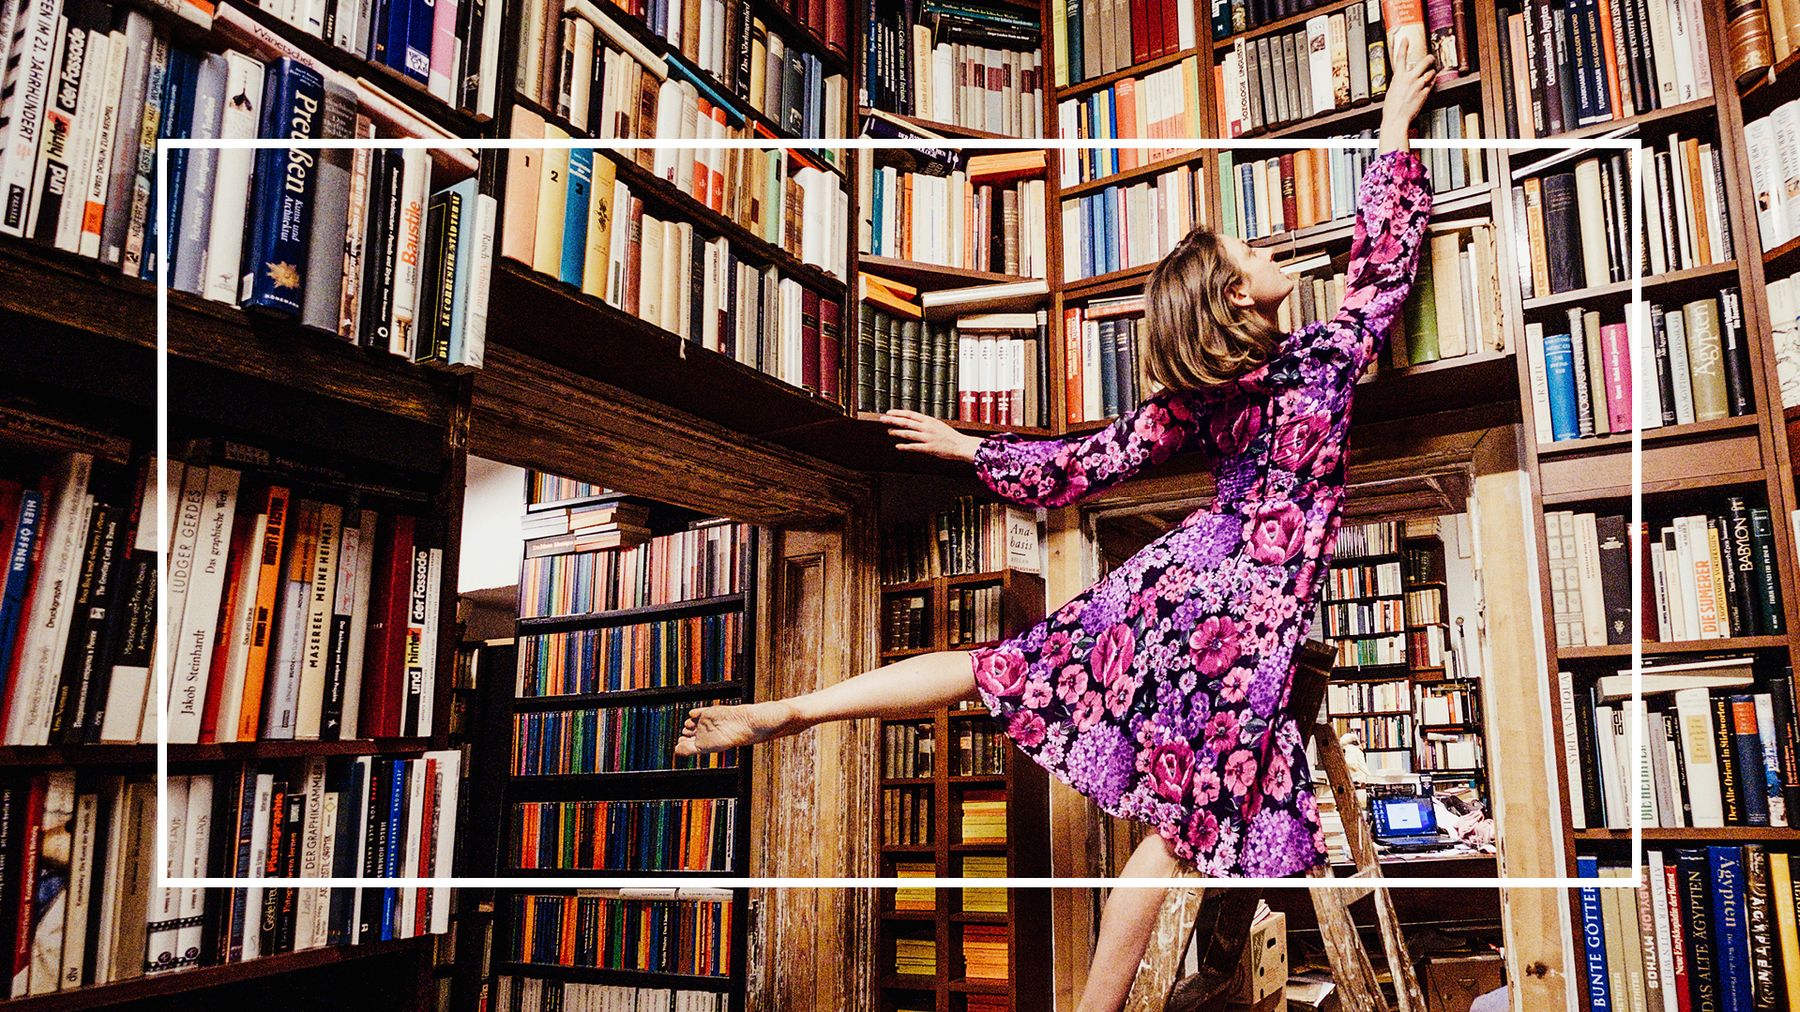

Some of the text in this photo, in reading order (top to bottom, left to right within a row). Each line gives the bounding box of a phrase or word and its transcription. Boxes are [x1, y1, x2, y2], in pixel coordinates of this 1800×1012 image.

[19, 19, 51, 143] IM 21. JAHRHUNDERT
[47, 27, 86, 196] und hinter der Fassade
[1236, 42, 1249, 121] SOZIOLOGIE LINGUISTIK
[285, 89, 318, 195] Preußen
[524, 155, 530, 168] 1
[550, 170, 559, 183] 2
[280, 194, 294, 243] Architektur
[291, 199, 304, 242] Kunst und
[575, 182, 584, 195] 3
[401, 201, 421, 266] Baustile
[1692, 303, 1719, 377] Ägypten
[13, 499, 37, 572] HIER ÖFFNEN
[172, 489, 201, 594] LUDGER GERDES
[207, 512, 226, 556] graphische
[1010, 523, 1033, 537] Ana-
[1010, 535, 1033, 551] basis
[1732, 517, 1754, 571] BABYLON
[205, 558, 216, 574] Das
[309, 522, 332, 668] MASEREEL MEINE HEIMAT
[1695, 560, 1718, 633] DIE SUMERER
[45, 579, 63, 629] Druckgraphik
[407, 551, 428, 694] und hinter der Fassade
[181, 629, 206, 716] Jakob Steinhardt
[1561, 674, 1578, 765] SYRIA ANTIQUA
[1717, 702, 1738, 821] Der Alte Orient in Stichworten
[266, 792, 284, 873] Photographie
[305, 764, 324, 870] DER GRAPHIKSAMMLER
[1641, 801, 1654, 821] DIE
[1665, 873, 1676, 894] Kunst
[1667, 894, 1677, 906] der
[1717, 855, 1740, 928] Ägypten
[1644, 935, 1659, 989] MYTHOS
[1673, 955, 1685, 976] Neue
[1687, 869, 1714, 1012] DAS ALTE ÄGYPTEN
[1751, 896, 1769, 982] ÄGYPTEN
[1588, 953, 1606, 1007] BUNTE
